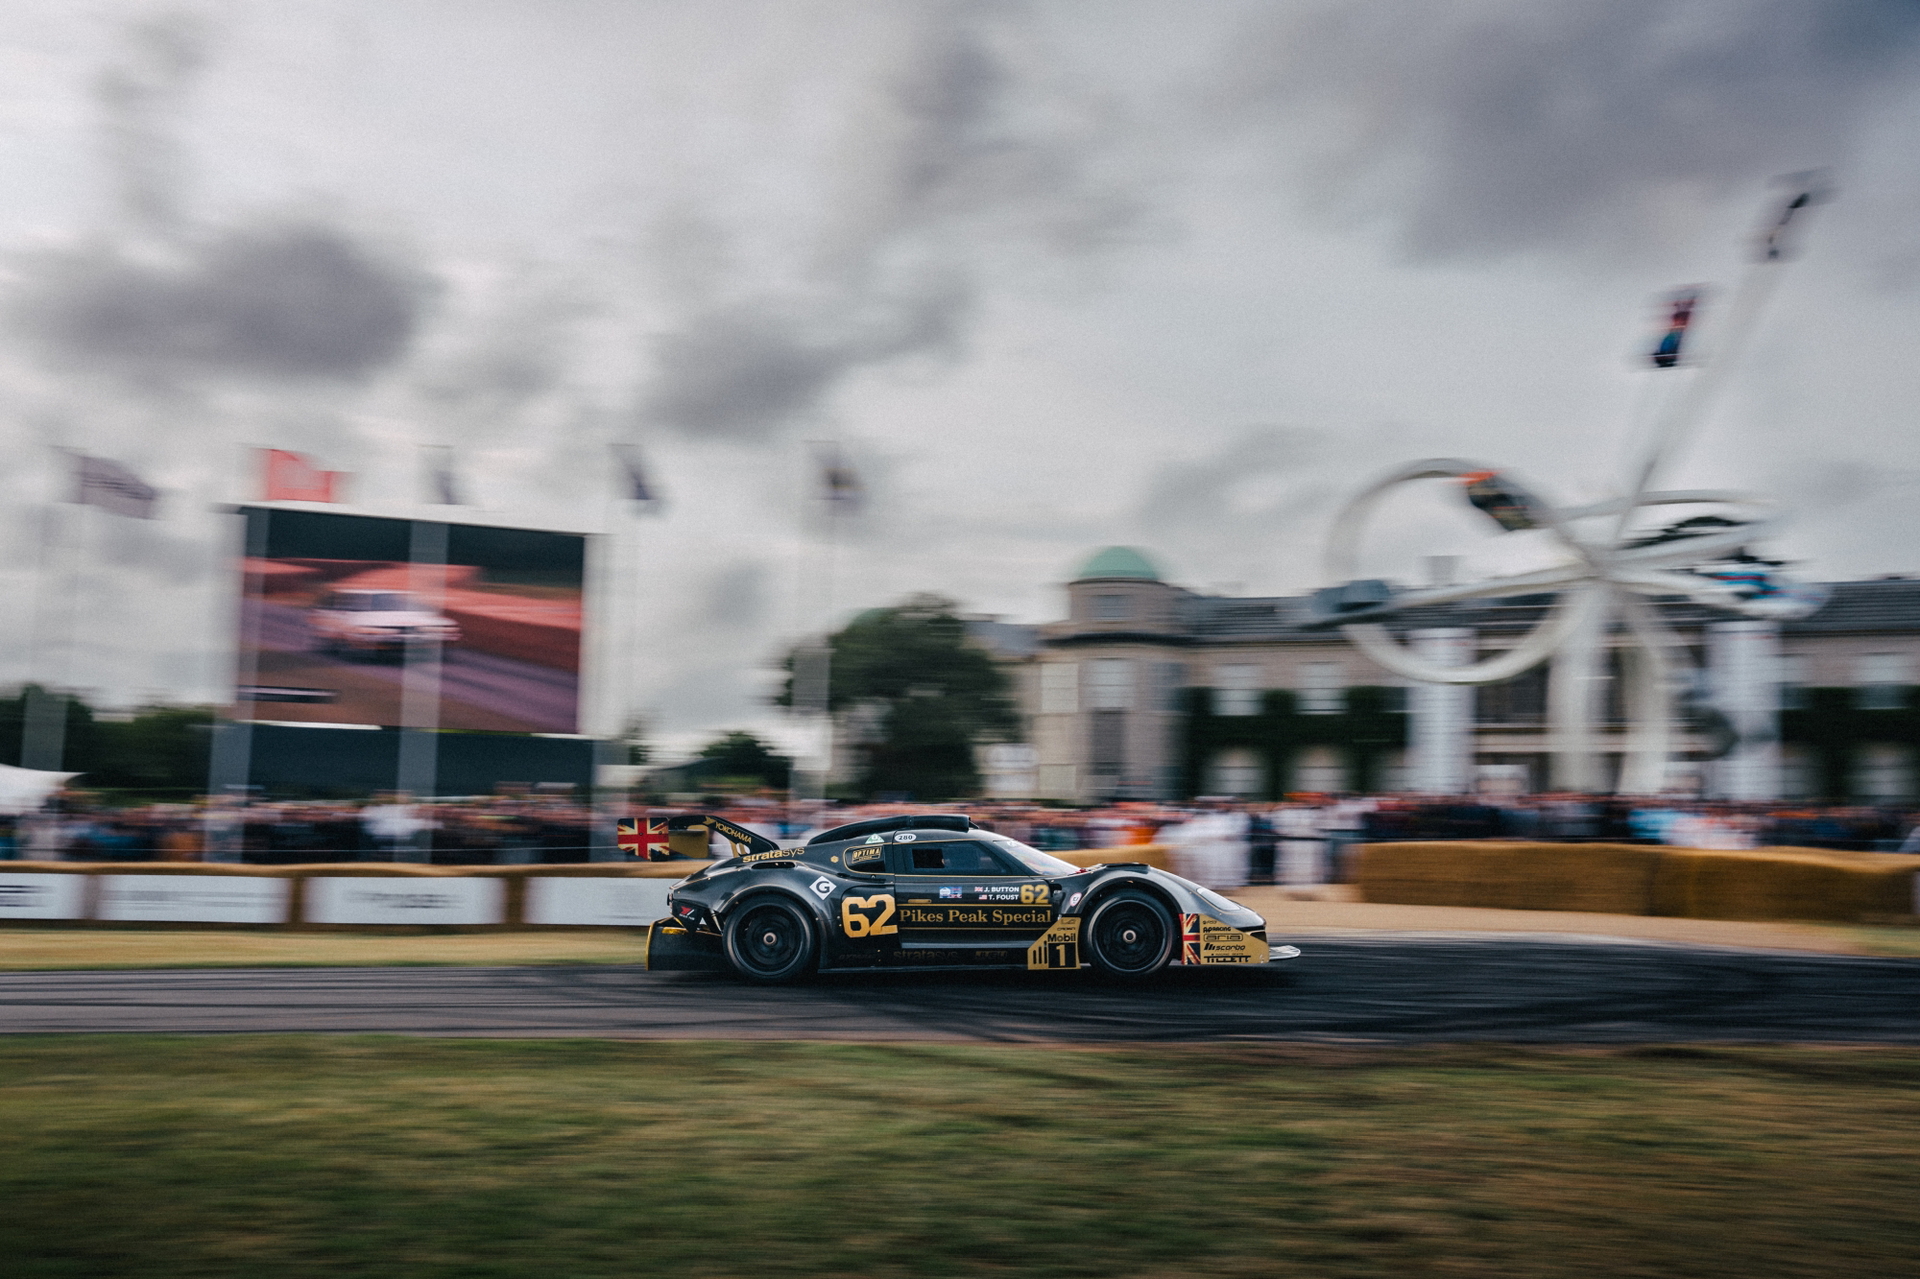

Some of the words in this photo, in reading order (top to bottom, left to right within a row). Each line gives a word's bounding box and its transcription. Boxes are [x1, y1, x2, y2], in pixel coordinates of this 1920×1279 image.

[715, 821, 752, 844] YOKOHAMA
[742, 847, 805, 863] stratasys
[852, 847, 880, 859] OPTIMA
[1020, 884, 1049, 904] 62
[841, 893, 899, 939] 62
[899, 909, 944, 923] Pikes
[948, 909, 988, 923] Peak
[992, 909, 1051, 926] Special
[1047, 933, 1076, 942] Mobil
[1056, 944, 1066, 966] 1
